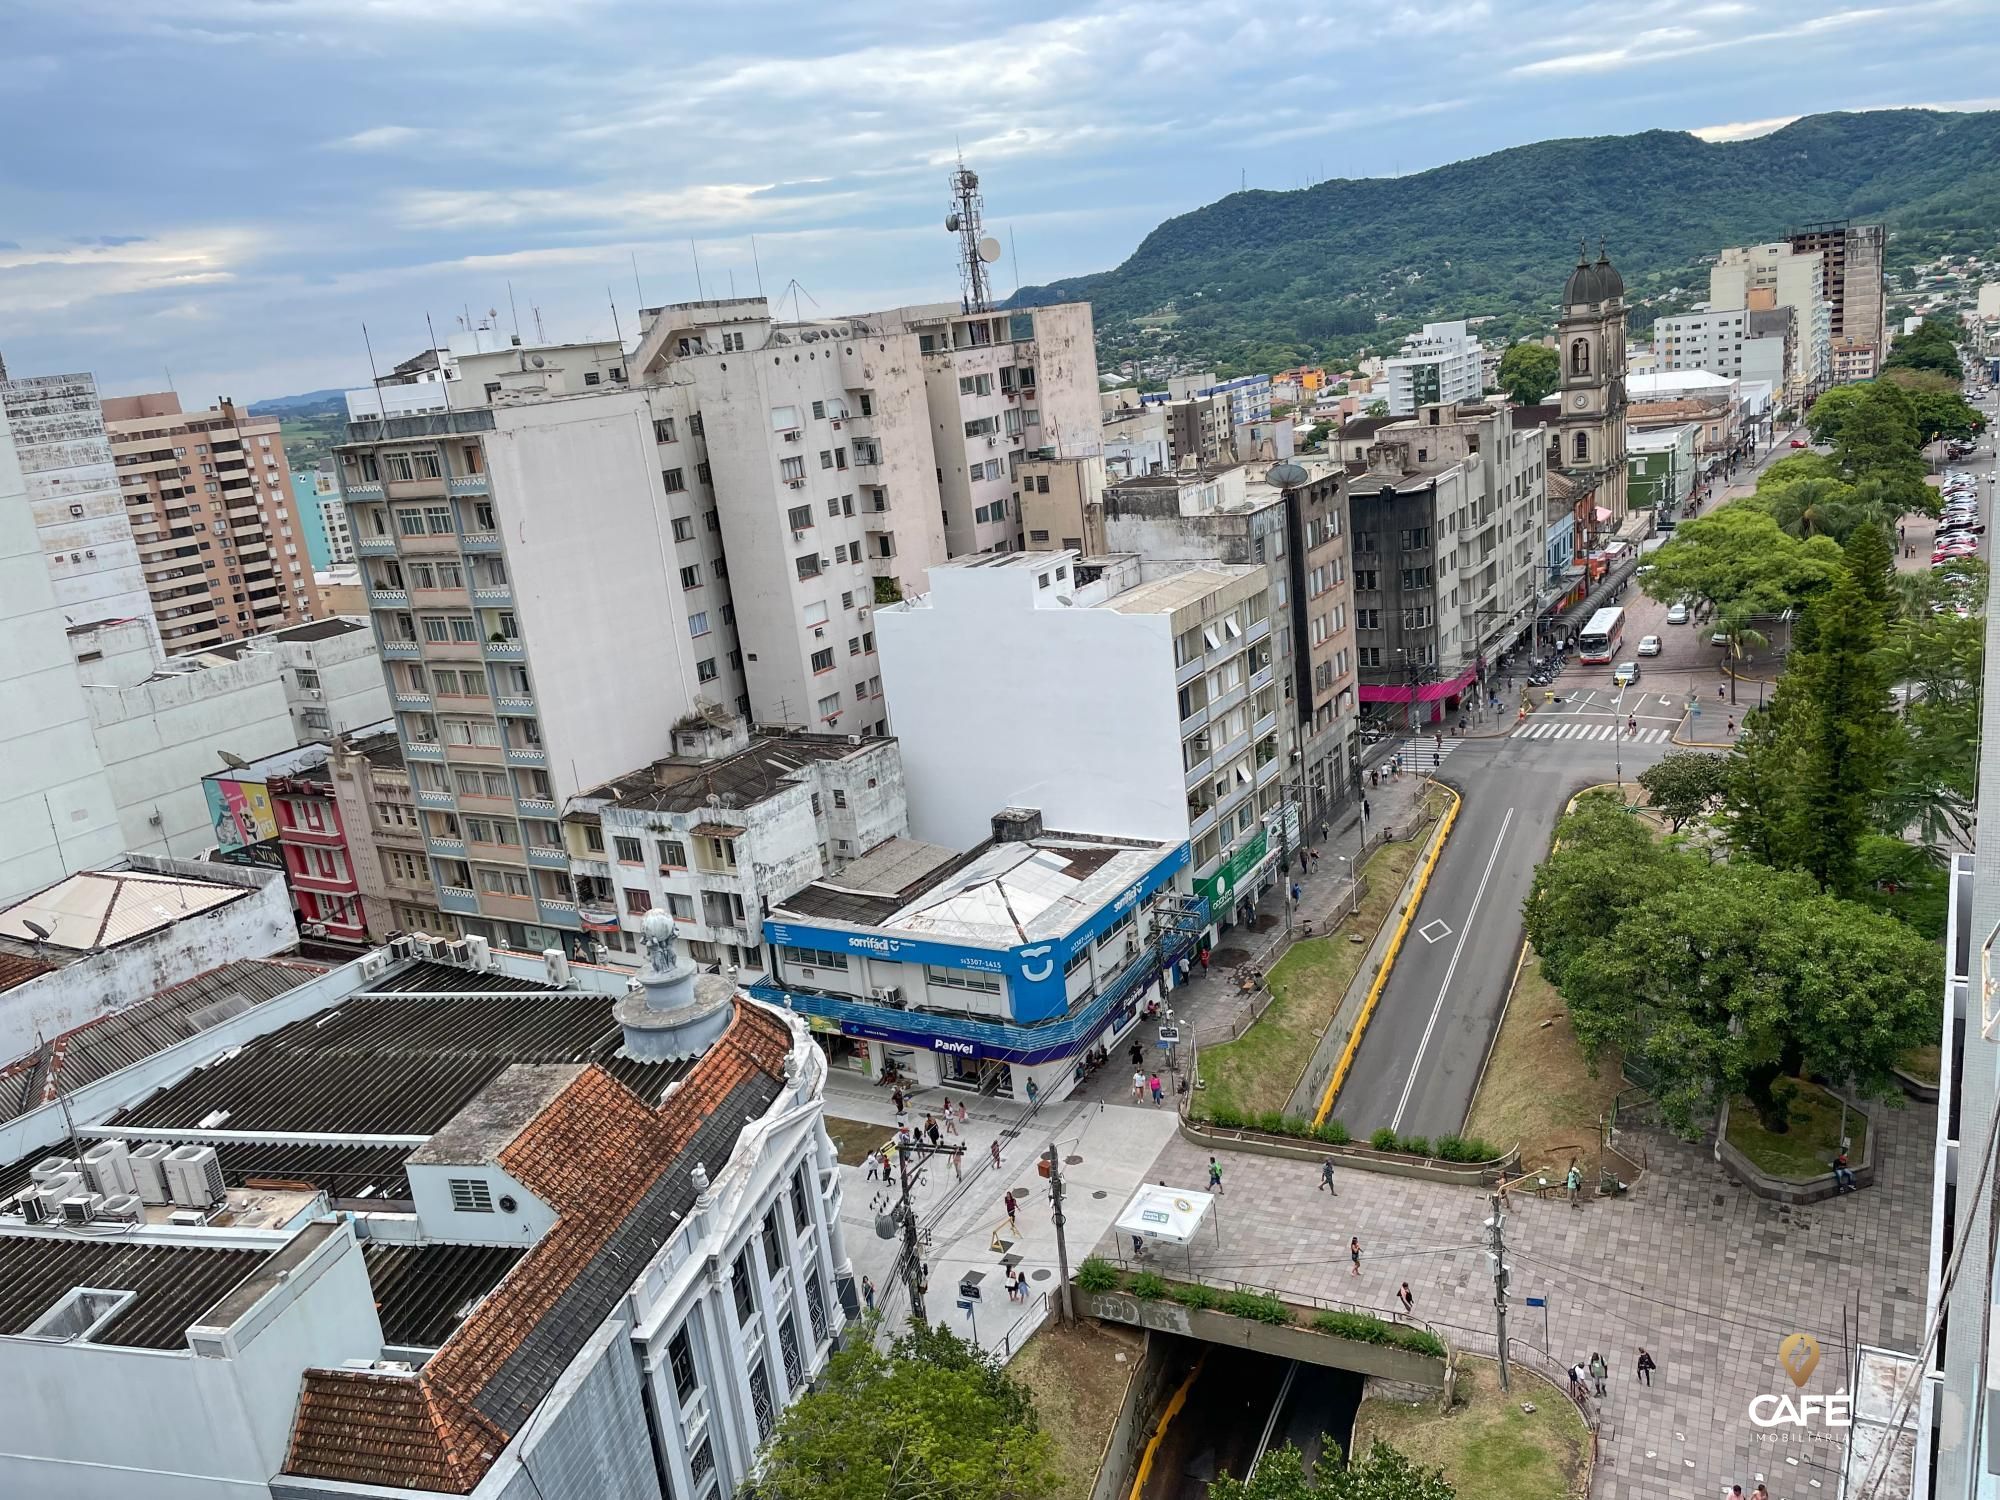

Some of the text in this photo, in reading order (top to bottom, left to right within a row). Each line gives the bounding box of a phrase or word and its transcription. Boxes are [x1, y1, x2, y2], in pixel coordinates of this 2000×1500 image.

[1212, 888, 1233, 910] ODONTO
[848, 936, 890, 951] sorrifácil
[934, 1039, 974, 1055] PanVel
